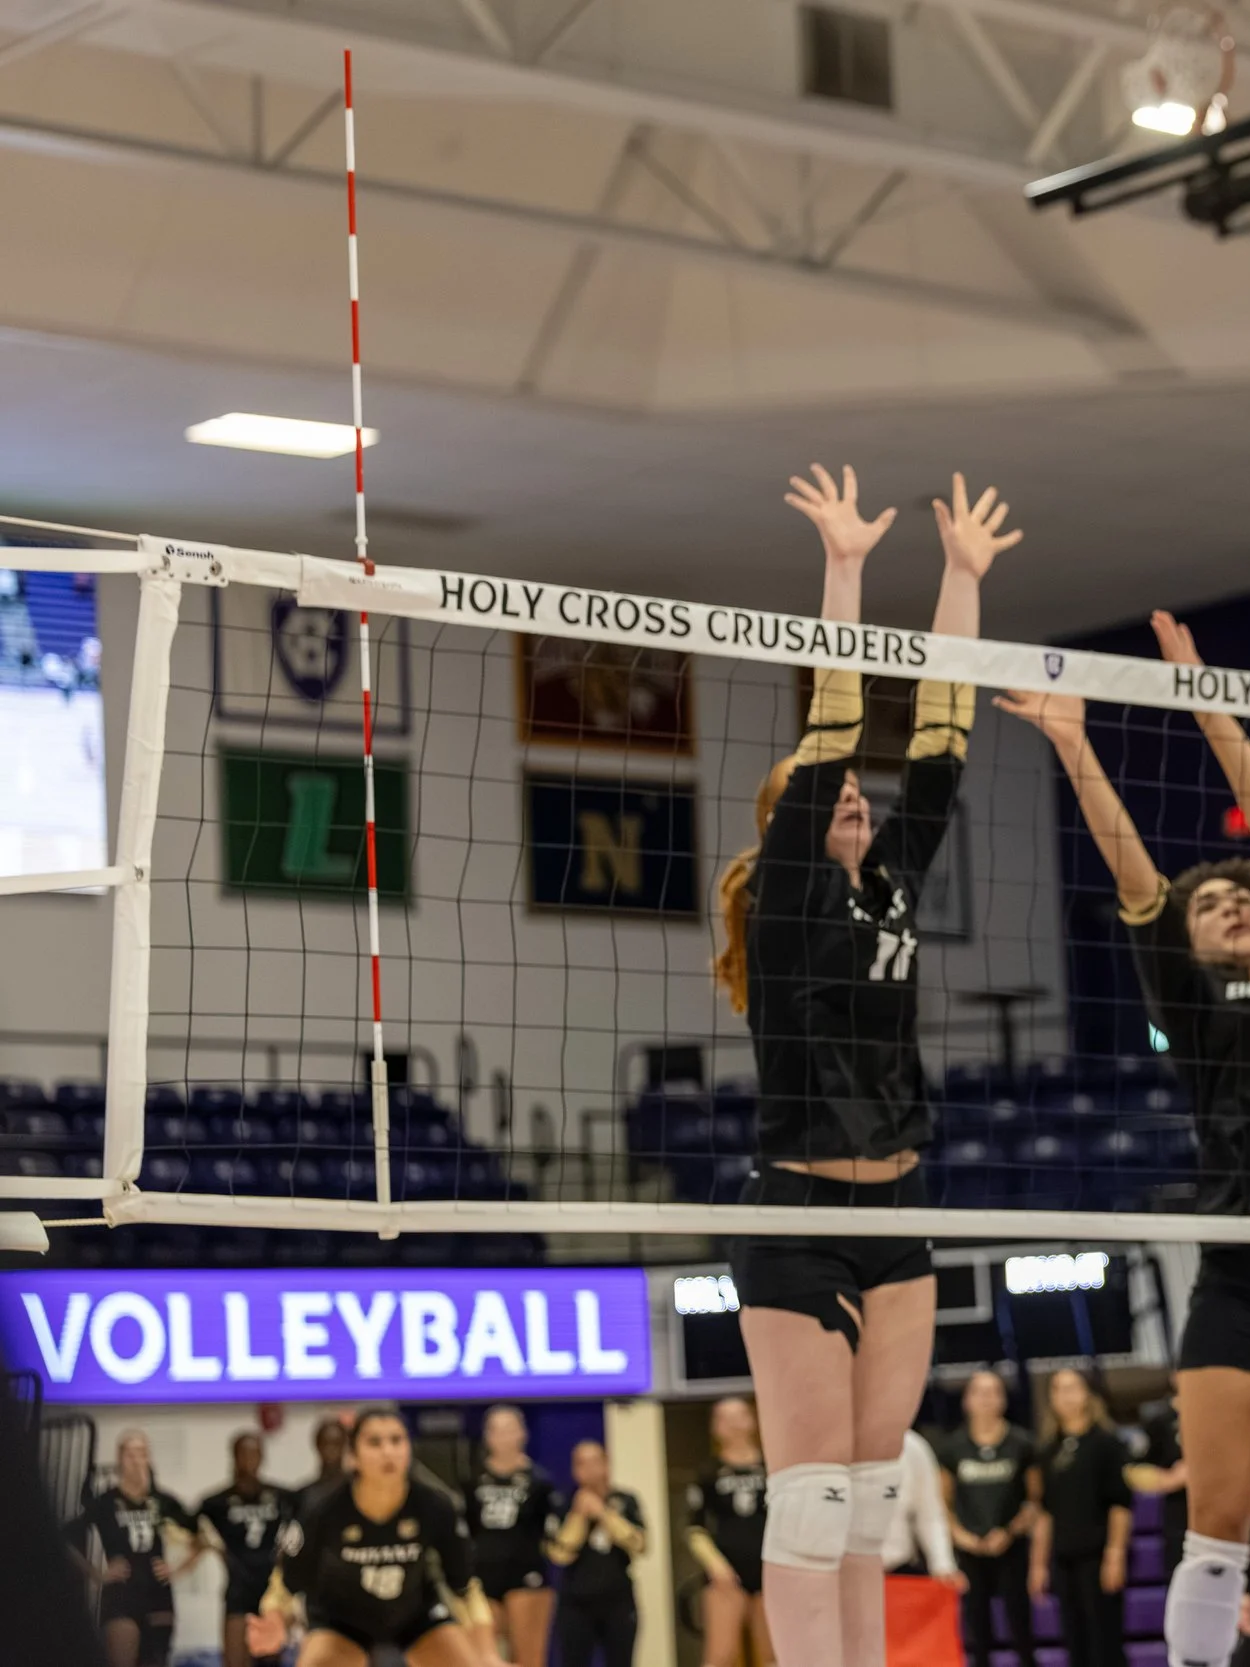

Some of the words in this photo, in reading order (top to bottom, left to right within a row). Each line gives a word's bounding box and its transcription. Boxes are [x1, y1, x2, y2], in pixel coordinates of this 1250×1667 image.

[439, 575, 544, 620] HOLY
[558, 591, 691, 636] CROSS
[707, 610, 927, 666] CRUSADERS
[20, 1290, 629, 1384] VOLLEYBALL
